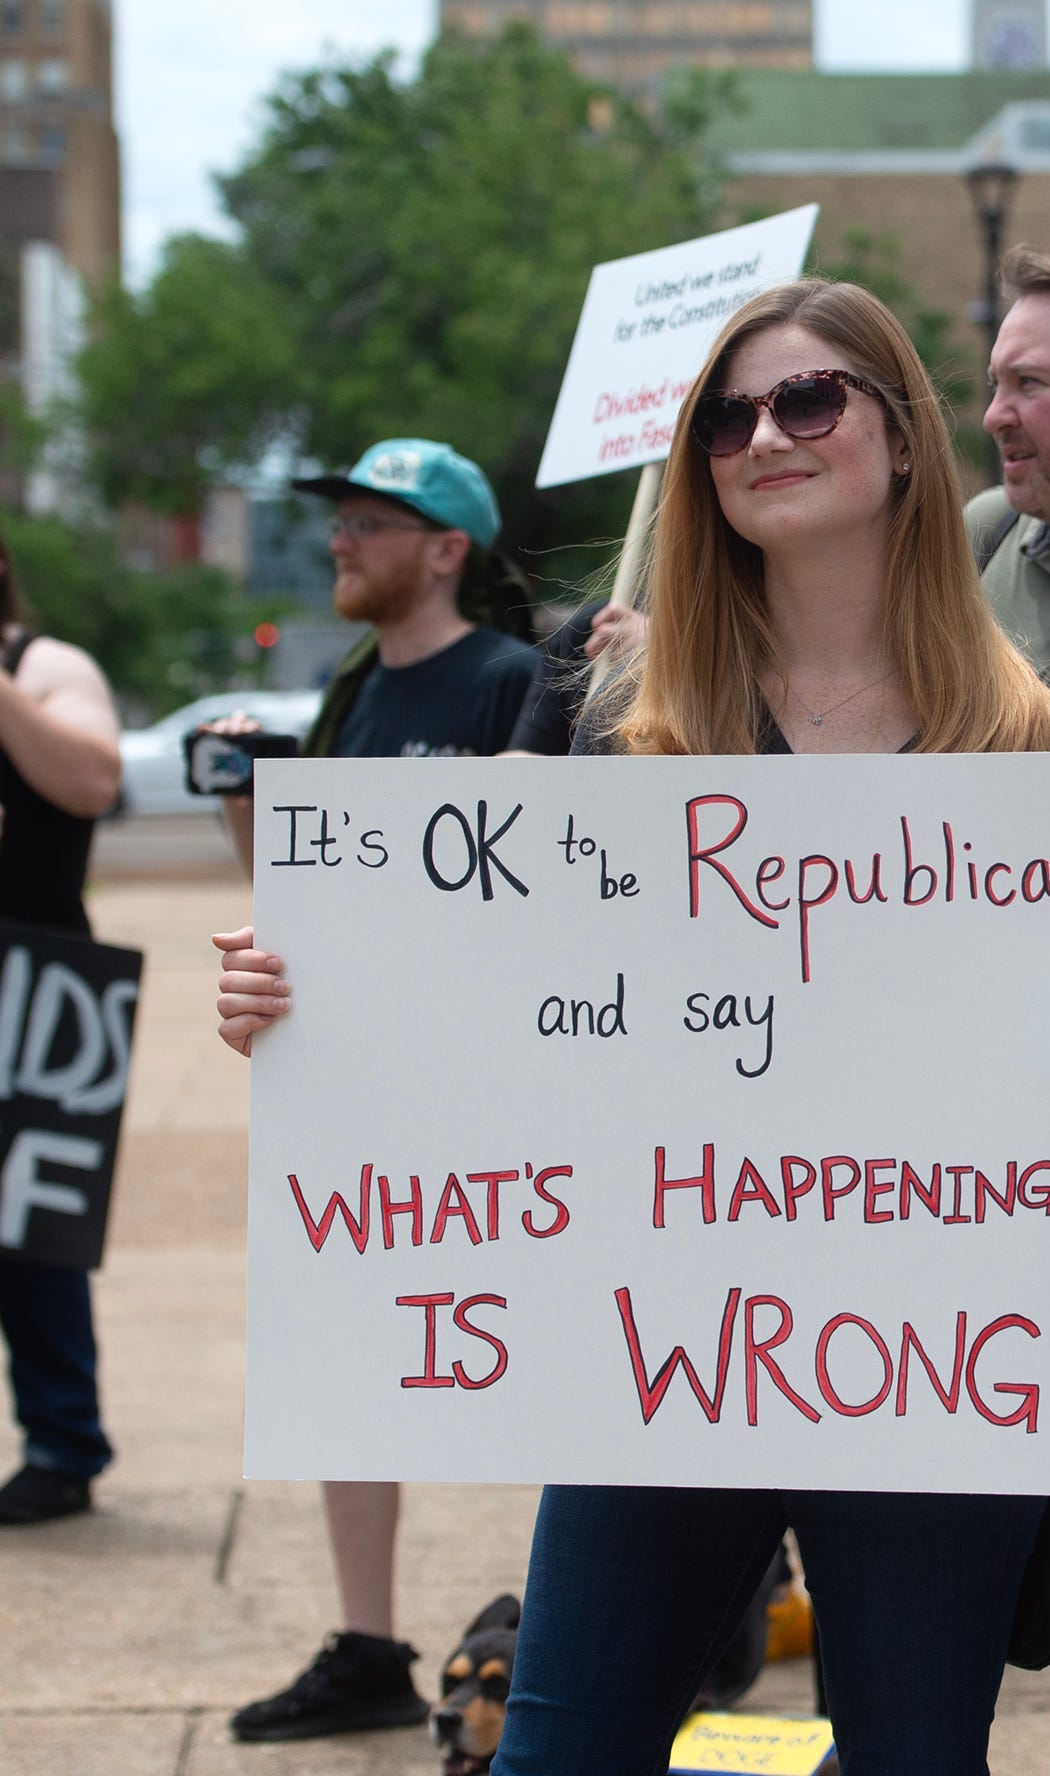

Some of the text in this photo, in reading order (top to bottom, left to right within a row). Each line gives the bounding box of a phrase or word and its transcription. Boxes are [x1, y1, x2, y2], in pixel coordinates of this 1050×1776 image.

[634, 250, 763, 307] United we stand
[613, 317, 636, 344] for
[640, 313, 665, 337] the
[594, 378, 669, 423] Divided
[598, 433, 634, 461] into
[271, 806, 389, 868] It's
[423, 800, 529, 901] OK
[557, 814, 596, 864] to
[600, 849, 640, 899] be
[538, 973, 774, 1078] and say
[287, 1162, 573, 1254] WHAT'S
[396, 1287, 1041, 1433] IS WRONG
